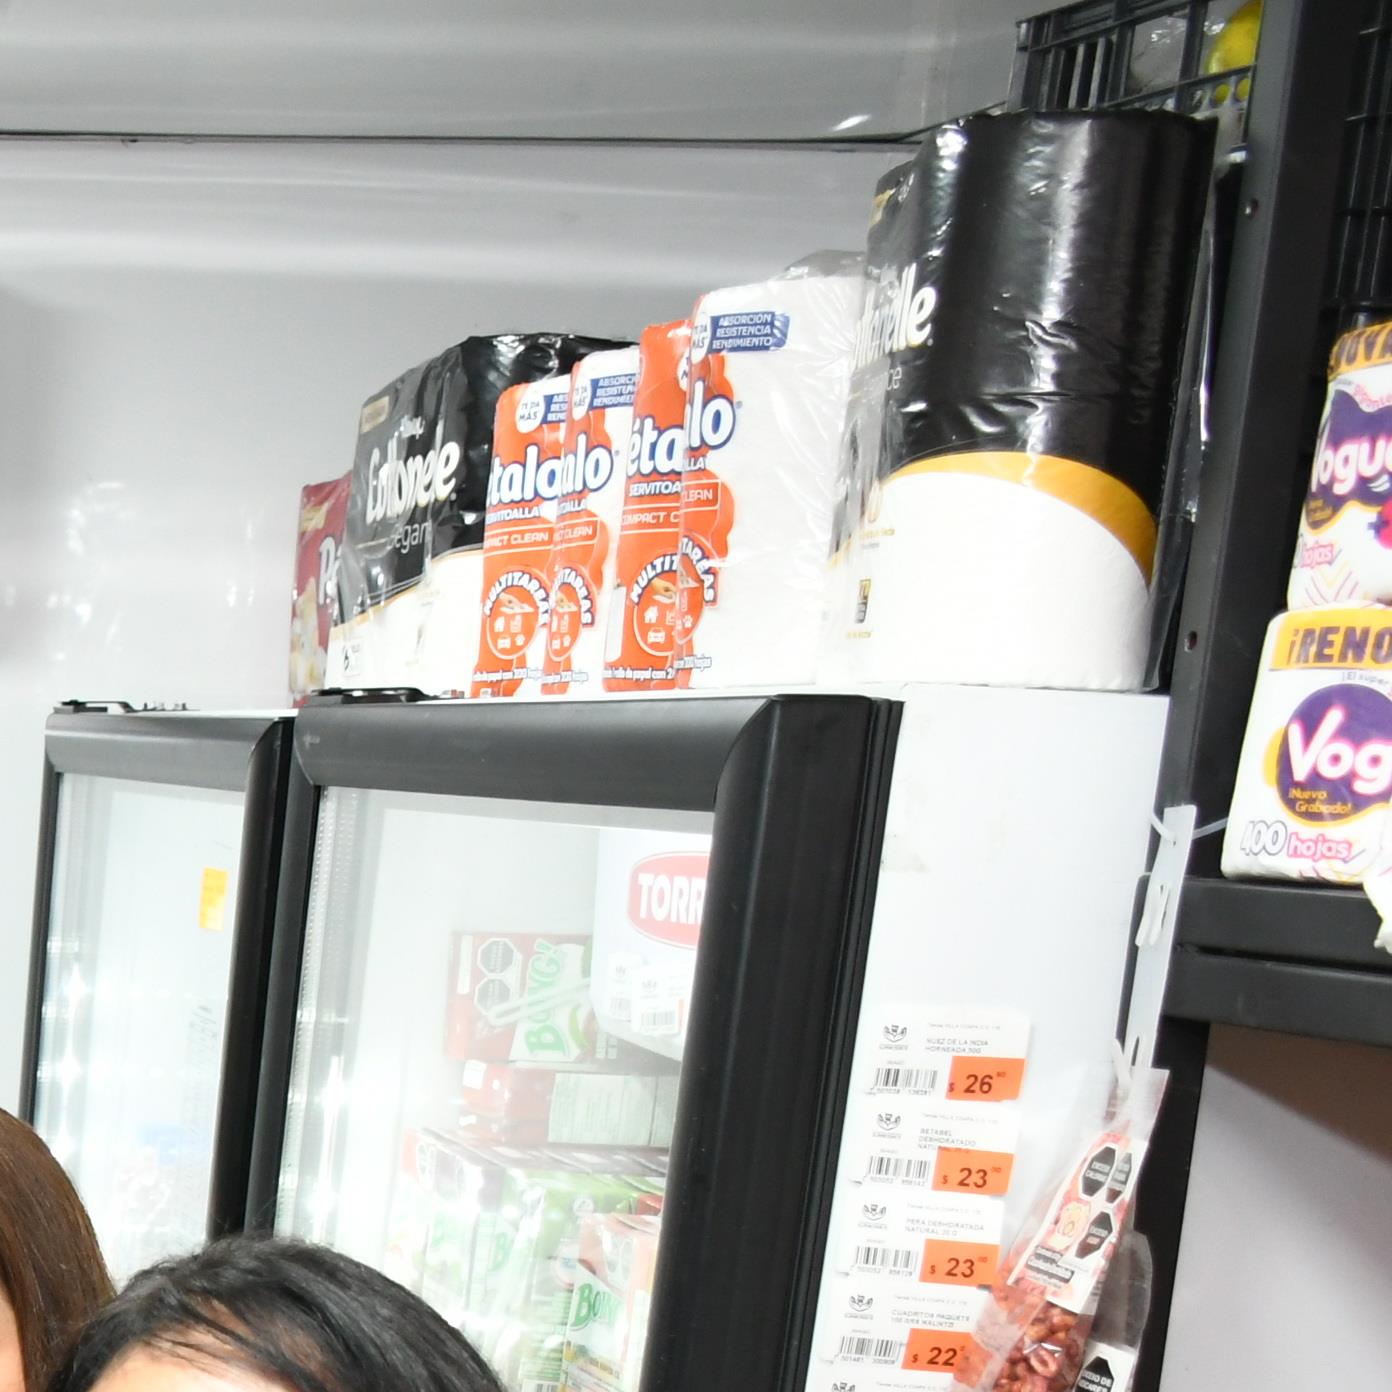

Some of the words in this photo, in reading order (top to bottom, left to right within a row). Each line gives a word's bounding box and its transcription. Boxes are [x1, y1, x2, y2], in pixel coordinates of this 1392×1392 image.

[1287, 833, 1353, 862] hojas
[964, 1073, 993, 1095] 26
[957, 1167, 988, 1189] 23
[945, 1257, 975, 1279] 23
[927, 1346, 958, 1367] 22
